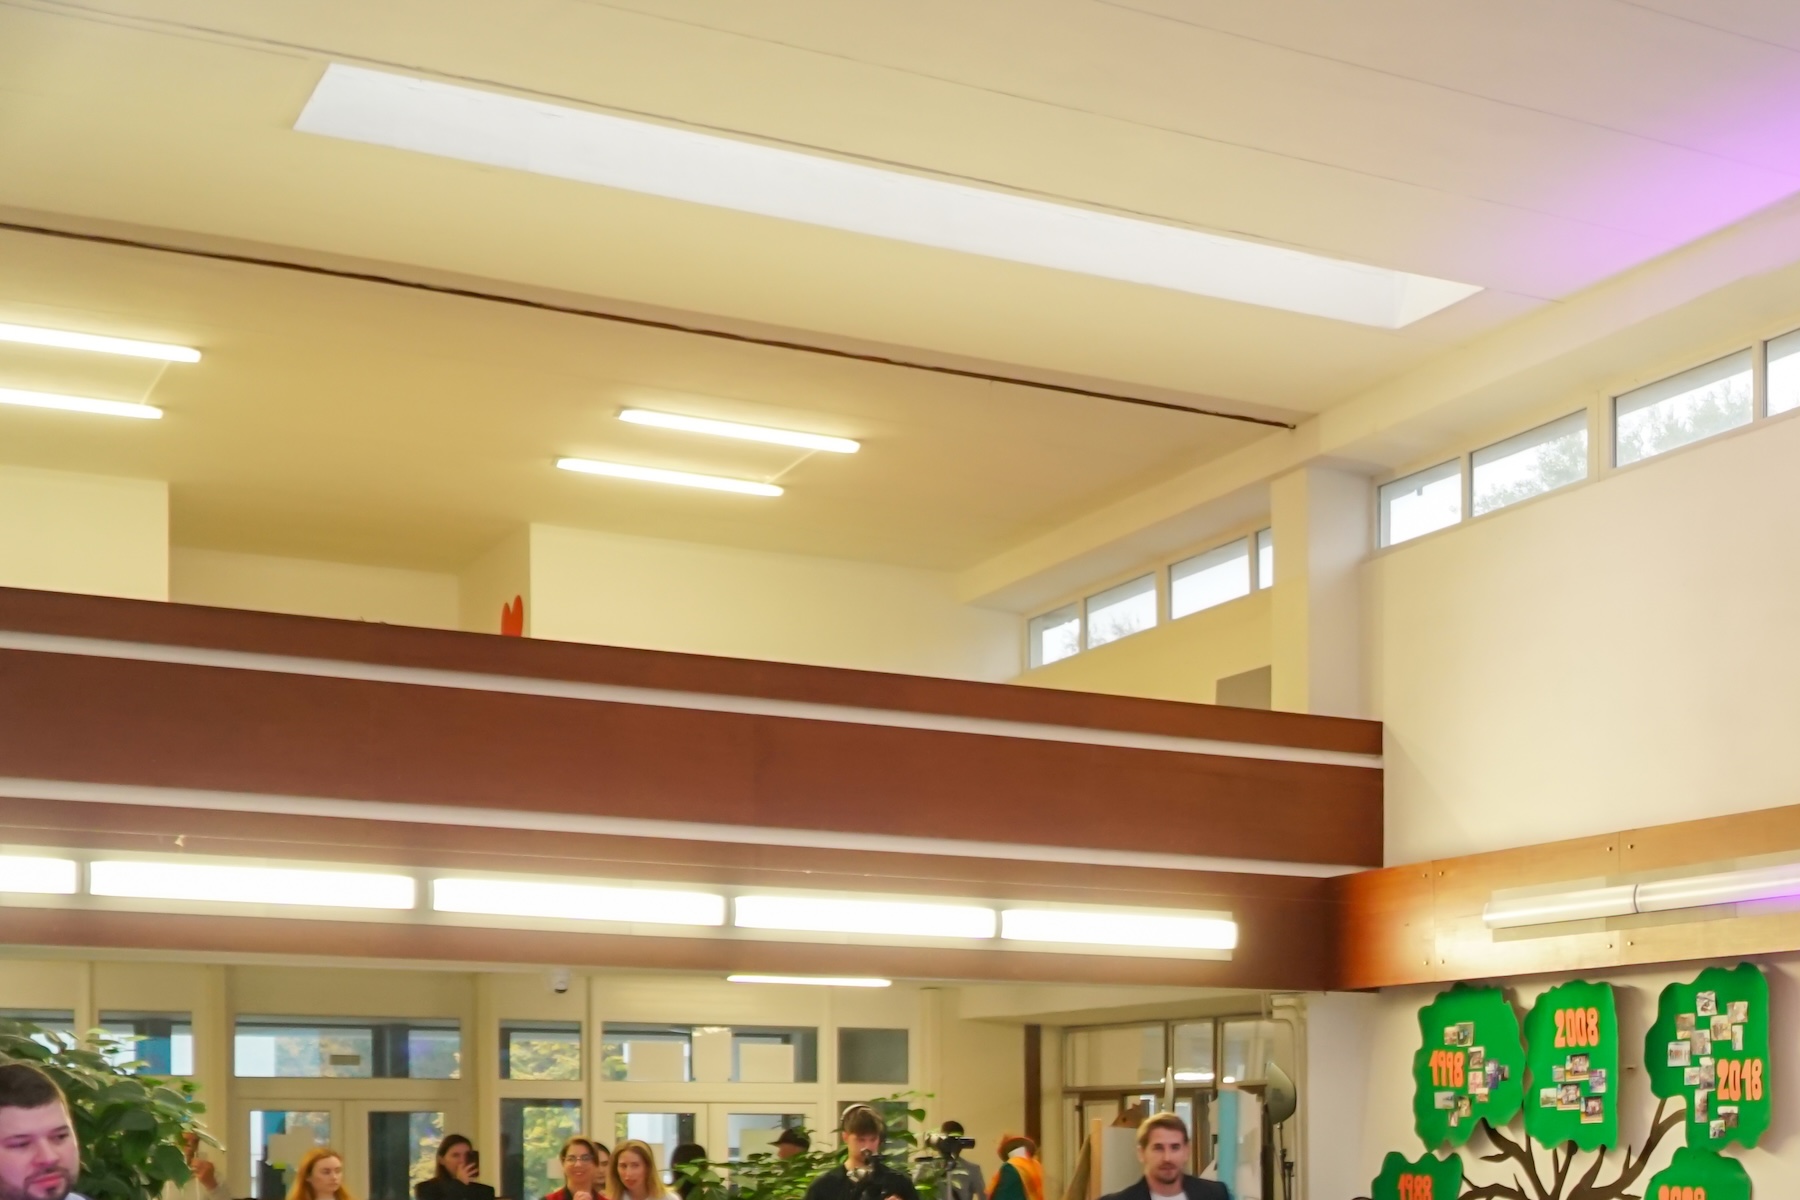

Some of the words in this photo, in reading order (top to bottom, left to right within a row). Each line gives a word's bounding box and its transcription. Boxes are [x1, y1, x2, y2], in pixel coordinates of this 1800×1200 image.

[1555, 1008, 1599, 1047] 2008
[1429, 1050, 1465, 1087] 1998
[1717, 1059, 1762, 1101] 2018
